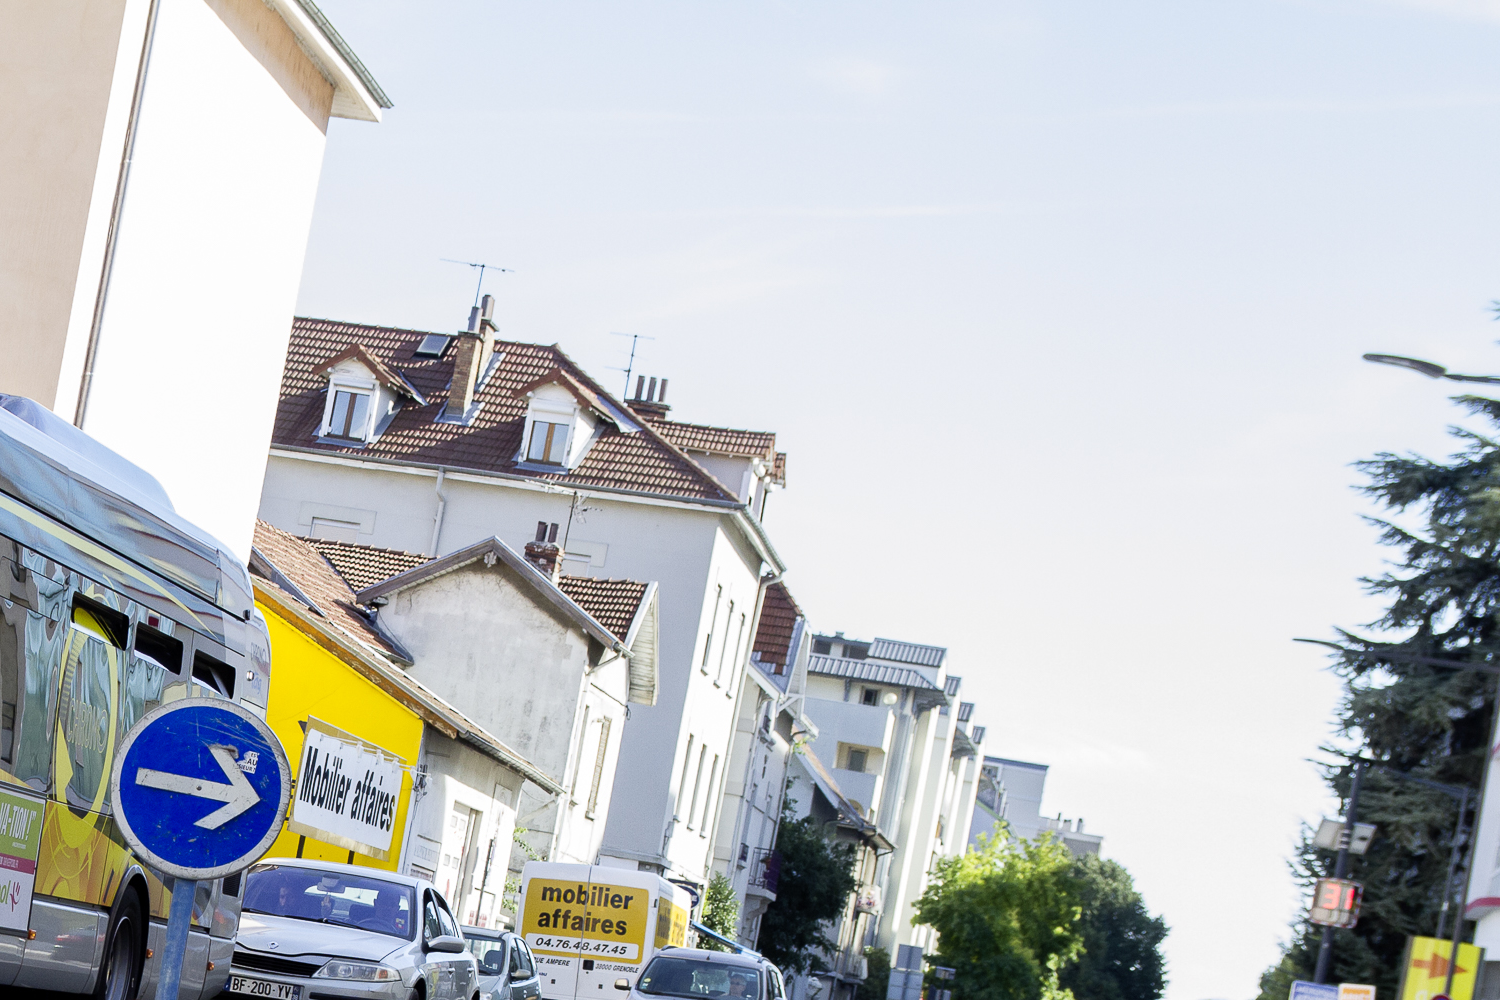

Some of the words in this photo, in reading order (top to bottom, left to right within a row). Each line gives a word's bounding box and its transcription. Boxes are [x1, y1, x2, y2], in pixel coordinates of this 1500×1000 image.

[300, 745, 352, 815] Mobilier
[350, 769, 396, 832] affaires
[541, 884, 634, 910] mobilier
[1322, 883, 1355, 910] 31
[537, 908, 628, 936] affaires
[535, 937, 628, 955] 04.76.48.47.45
[545, 958, 571, 967] AMPERE
[612, 965, 640, 974] GRENOBLE
[232, 977, 292, 999] BF-200-YV
